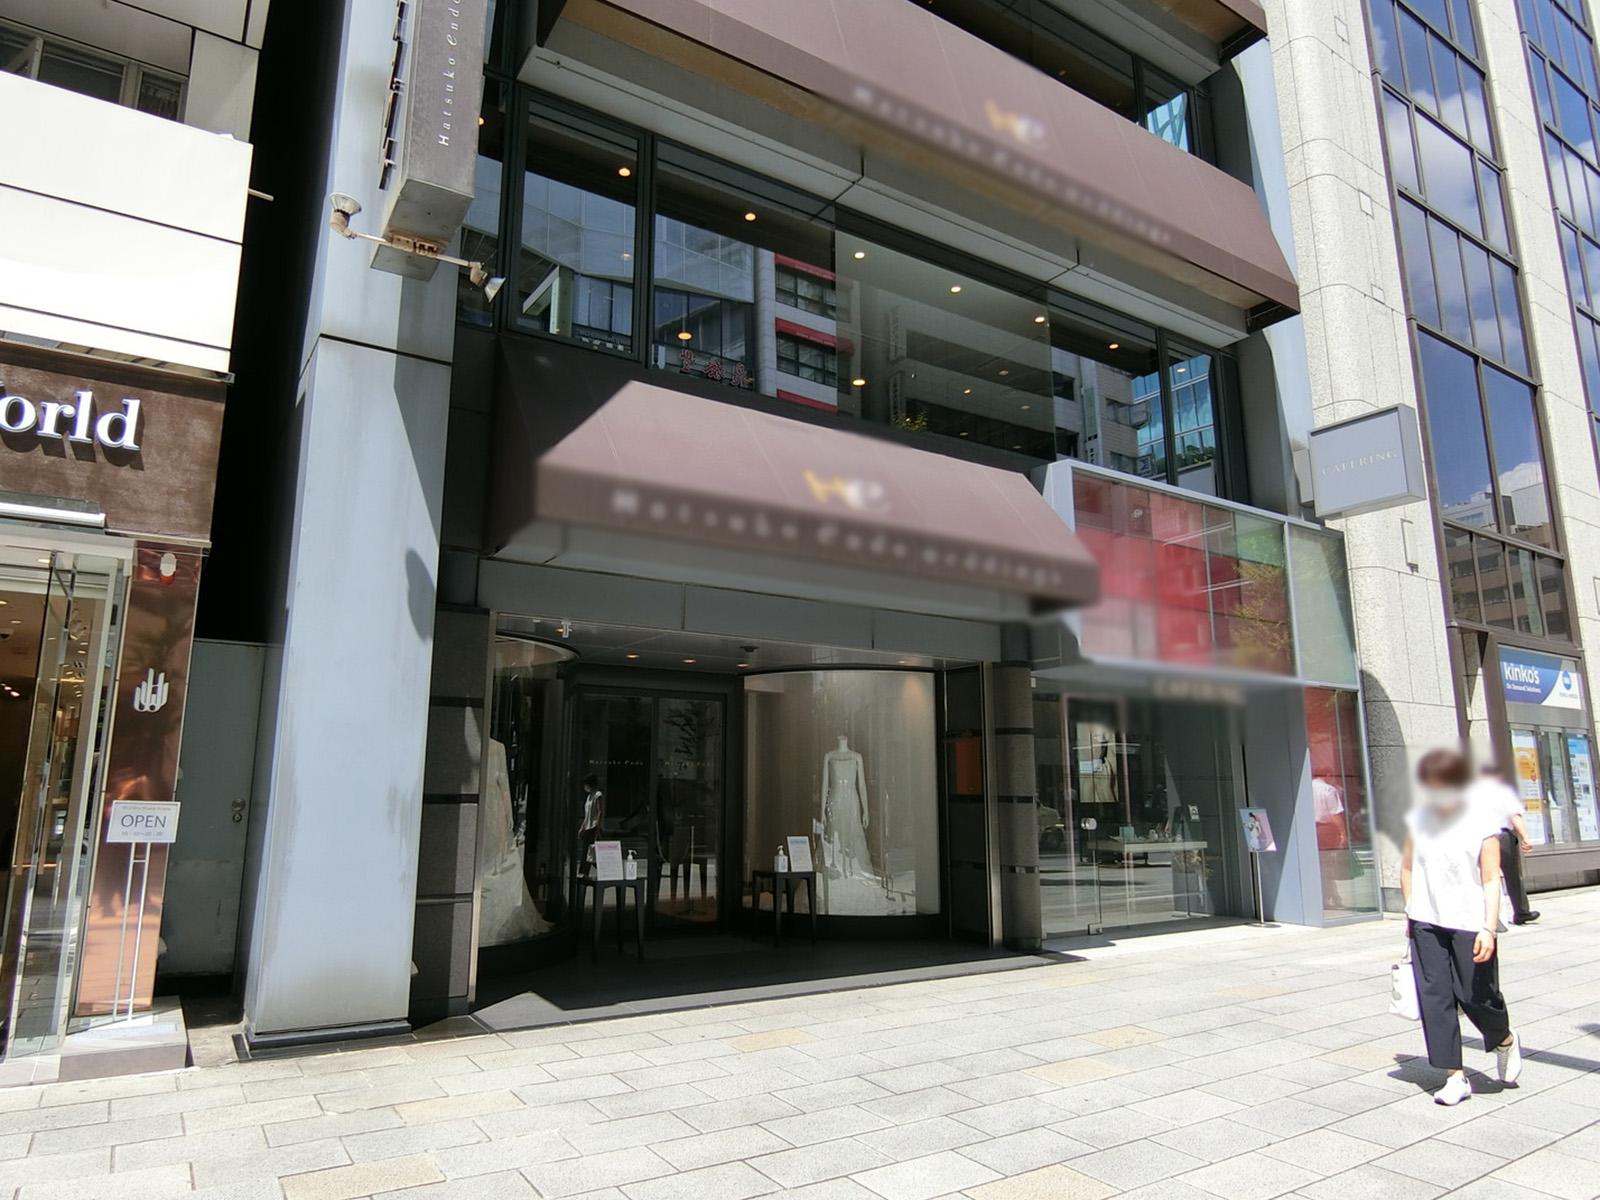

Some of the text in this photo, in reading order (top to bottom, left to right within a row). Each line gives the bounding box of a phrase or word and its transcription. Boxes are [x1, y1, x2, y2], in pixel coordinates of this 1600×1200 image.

[438, 58, 456, 147] Hatsuko
[0, 381, 141, 451] orld
[1504, 662, 1540, 684] kinko's
[121, 814, 167, 828] OPEN
